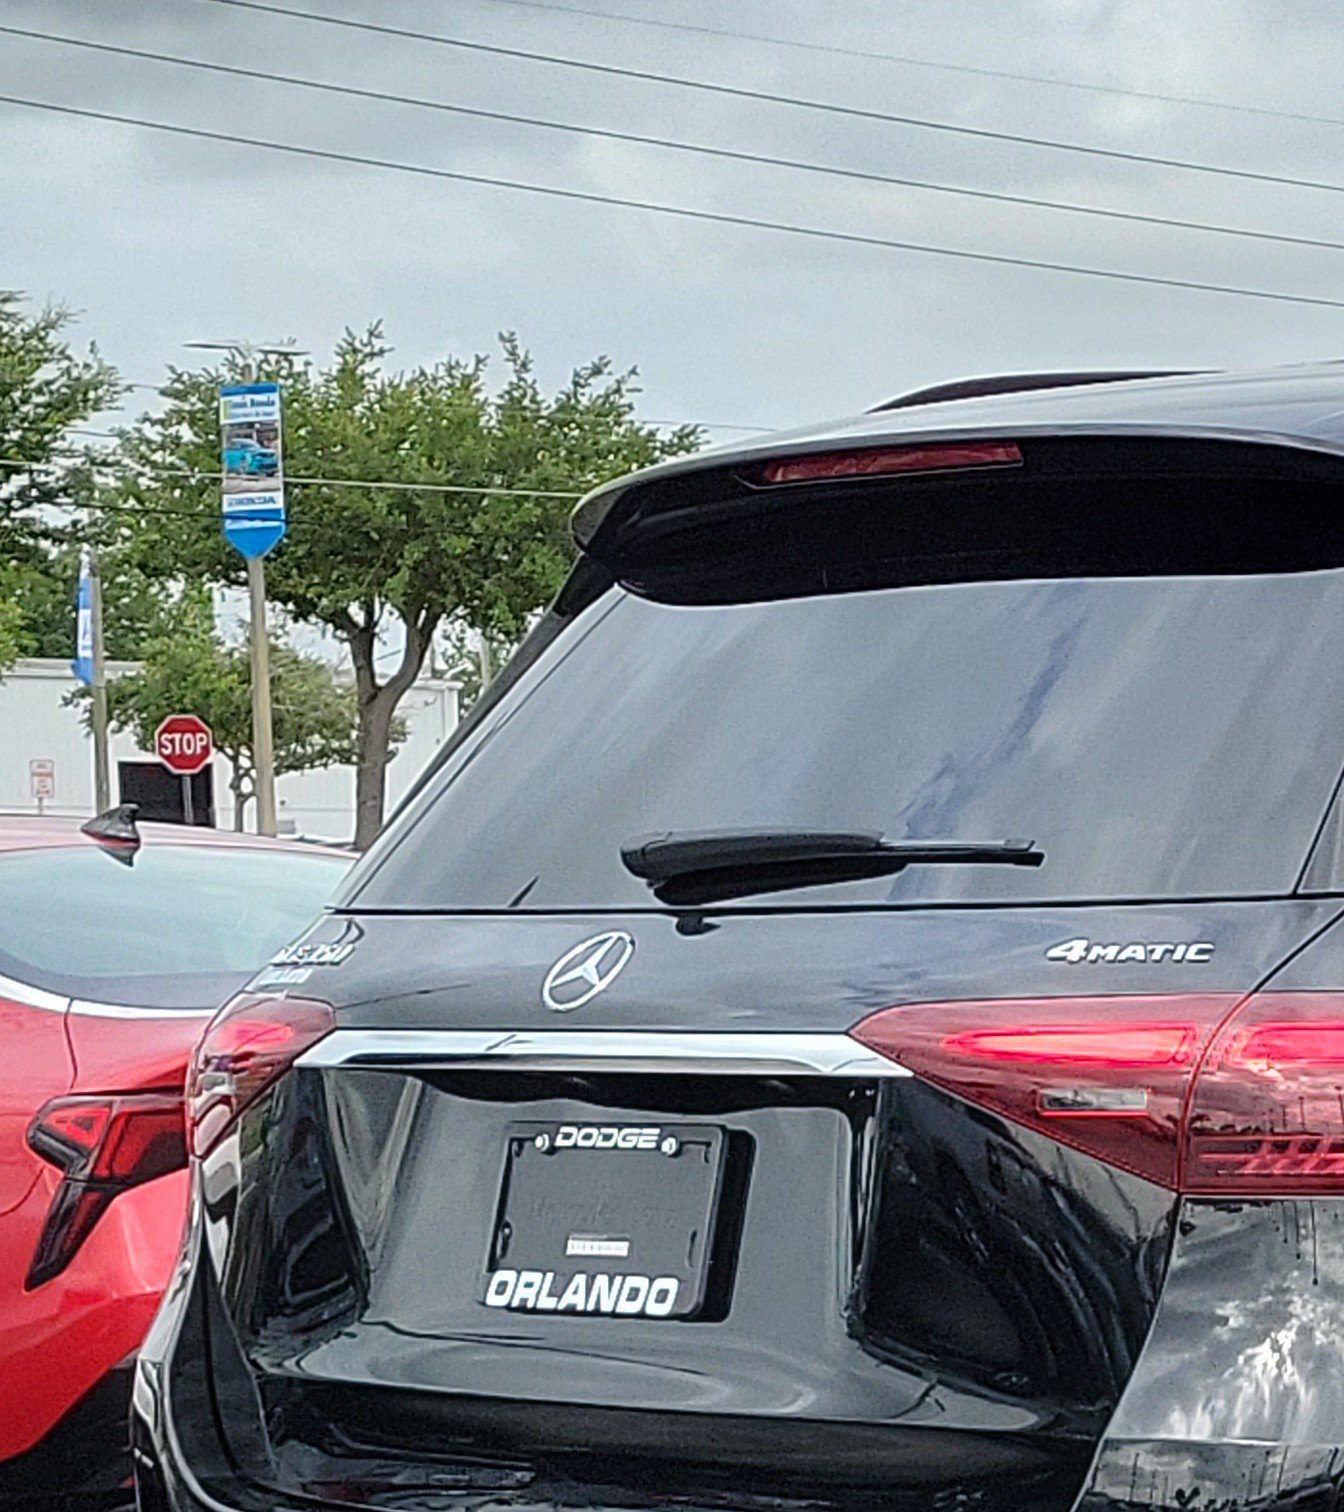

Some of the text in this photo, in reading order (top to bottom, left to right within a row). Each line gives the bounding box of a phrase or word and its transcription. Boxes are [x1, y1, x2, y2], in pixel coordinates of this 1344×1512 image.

[160, 732, 208, 756] STOP
[1045, 938, 1215, 963] 4MATIC
[554, 1126, 661, 1149] DODGE
[485, 1269, 680, 1316] ORLANDO
